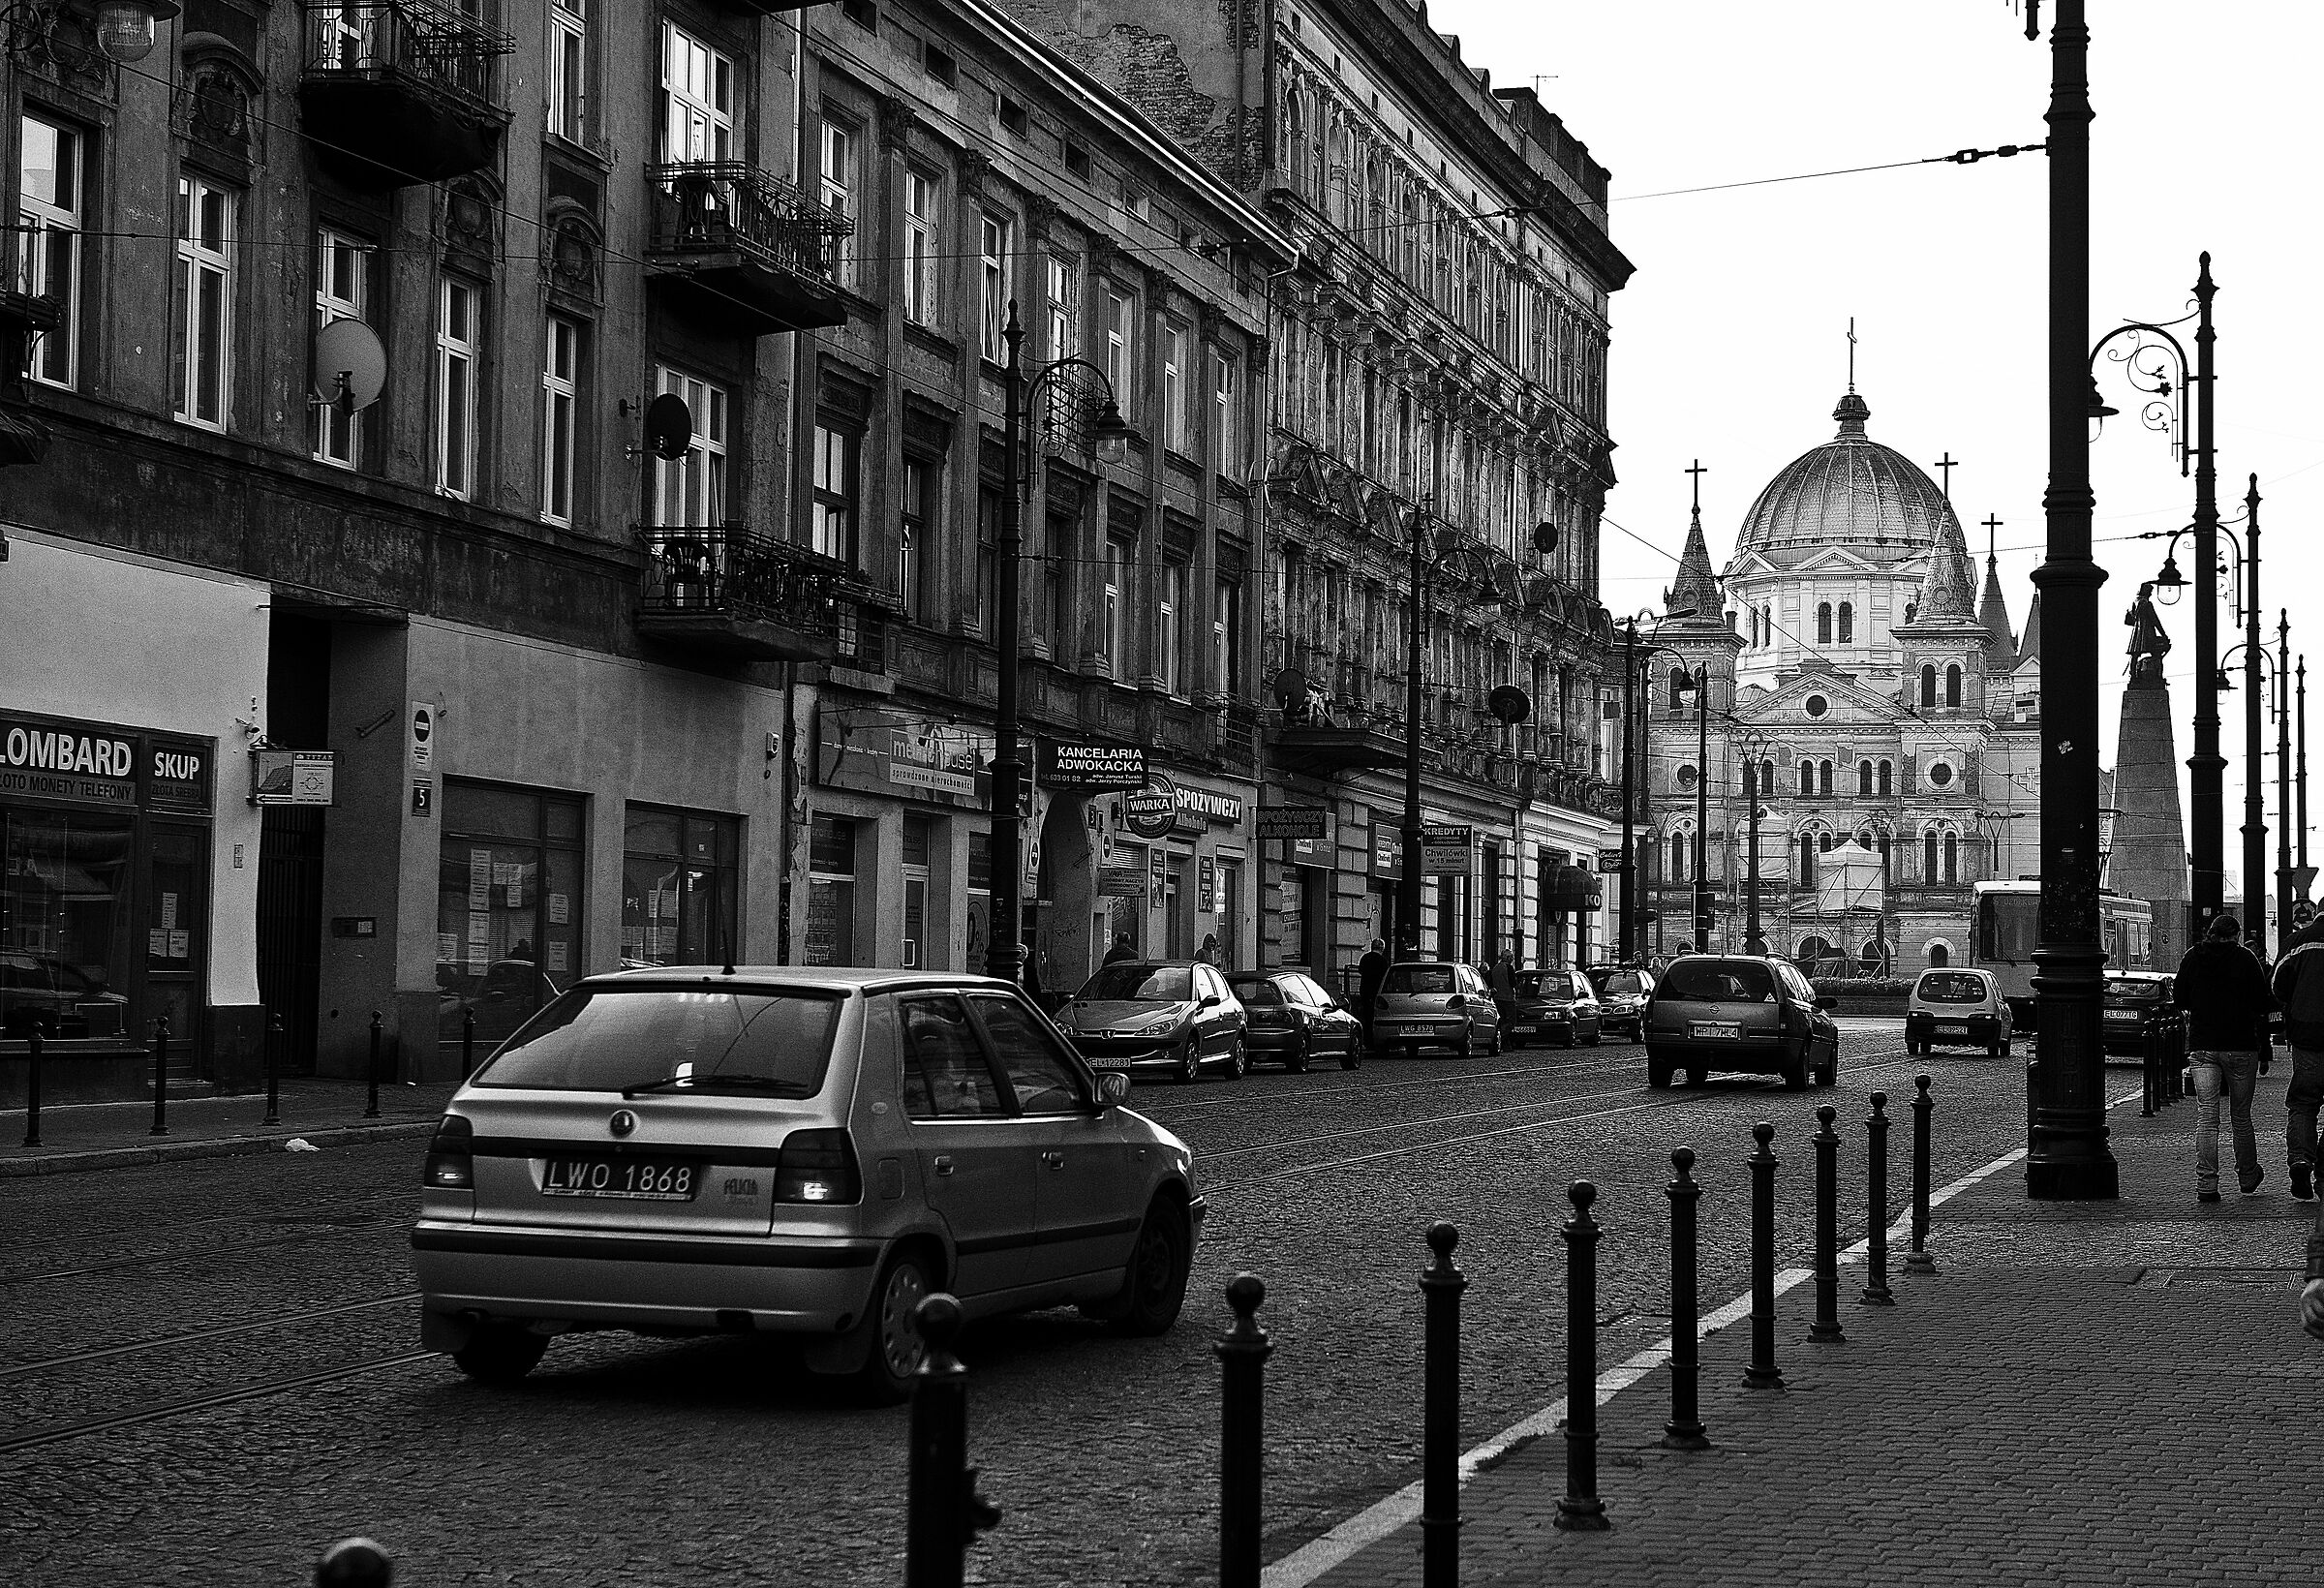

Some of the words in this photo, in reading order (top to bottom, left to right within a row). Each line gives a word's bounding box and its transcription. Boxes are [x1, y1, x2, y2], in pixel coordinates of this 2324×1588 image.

[0, 728, 132, 776] OMBARD
[1057, 747, 1143, 759] KANCELARIA
[154, 751, 199, 780] SKUP
[1057, 759, 1143, 772] ADWOKACKA
[30, 776, 76, 795] MONETY
[79, 780, 132, 801] TELEFONY
[419, 789, 425, 806] 5
[1176, 788, 1240, 819] SPOŻYWCZY
[1129, 799, 1170, 811] WARKA
[1090, 810, 1095, 823] 3
[1257, 809, 1325, 823] SPOŻYWCZY
[1259, 824, 1320, 838] ALKOHOLE
[1424, 827, 1469, 836] KREDYTY
[1424, 848, 1468, 857] Chwilówki
[548, 1162, 610, 1188] LWO
[626, 1164, 691, 1193] 1868
